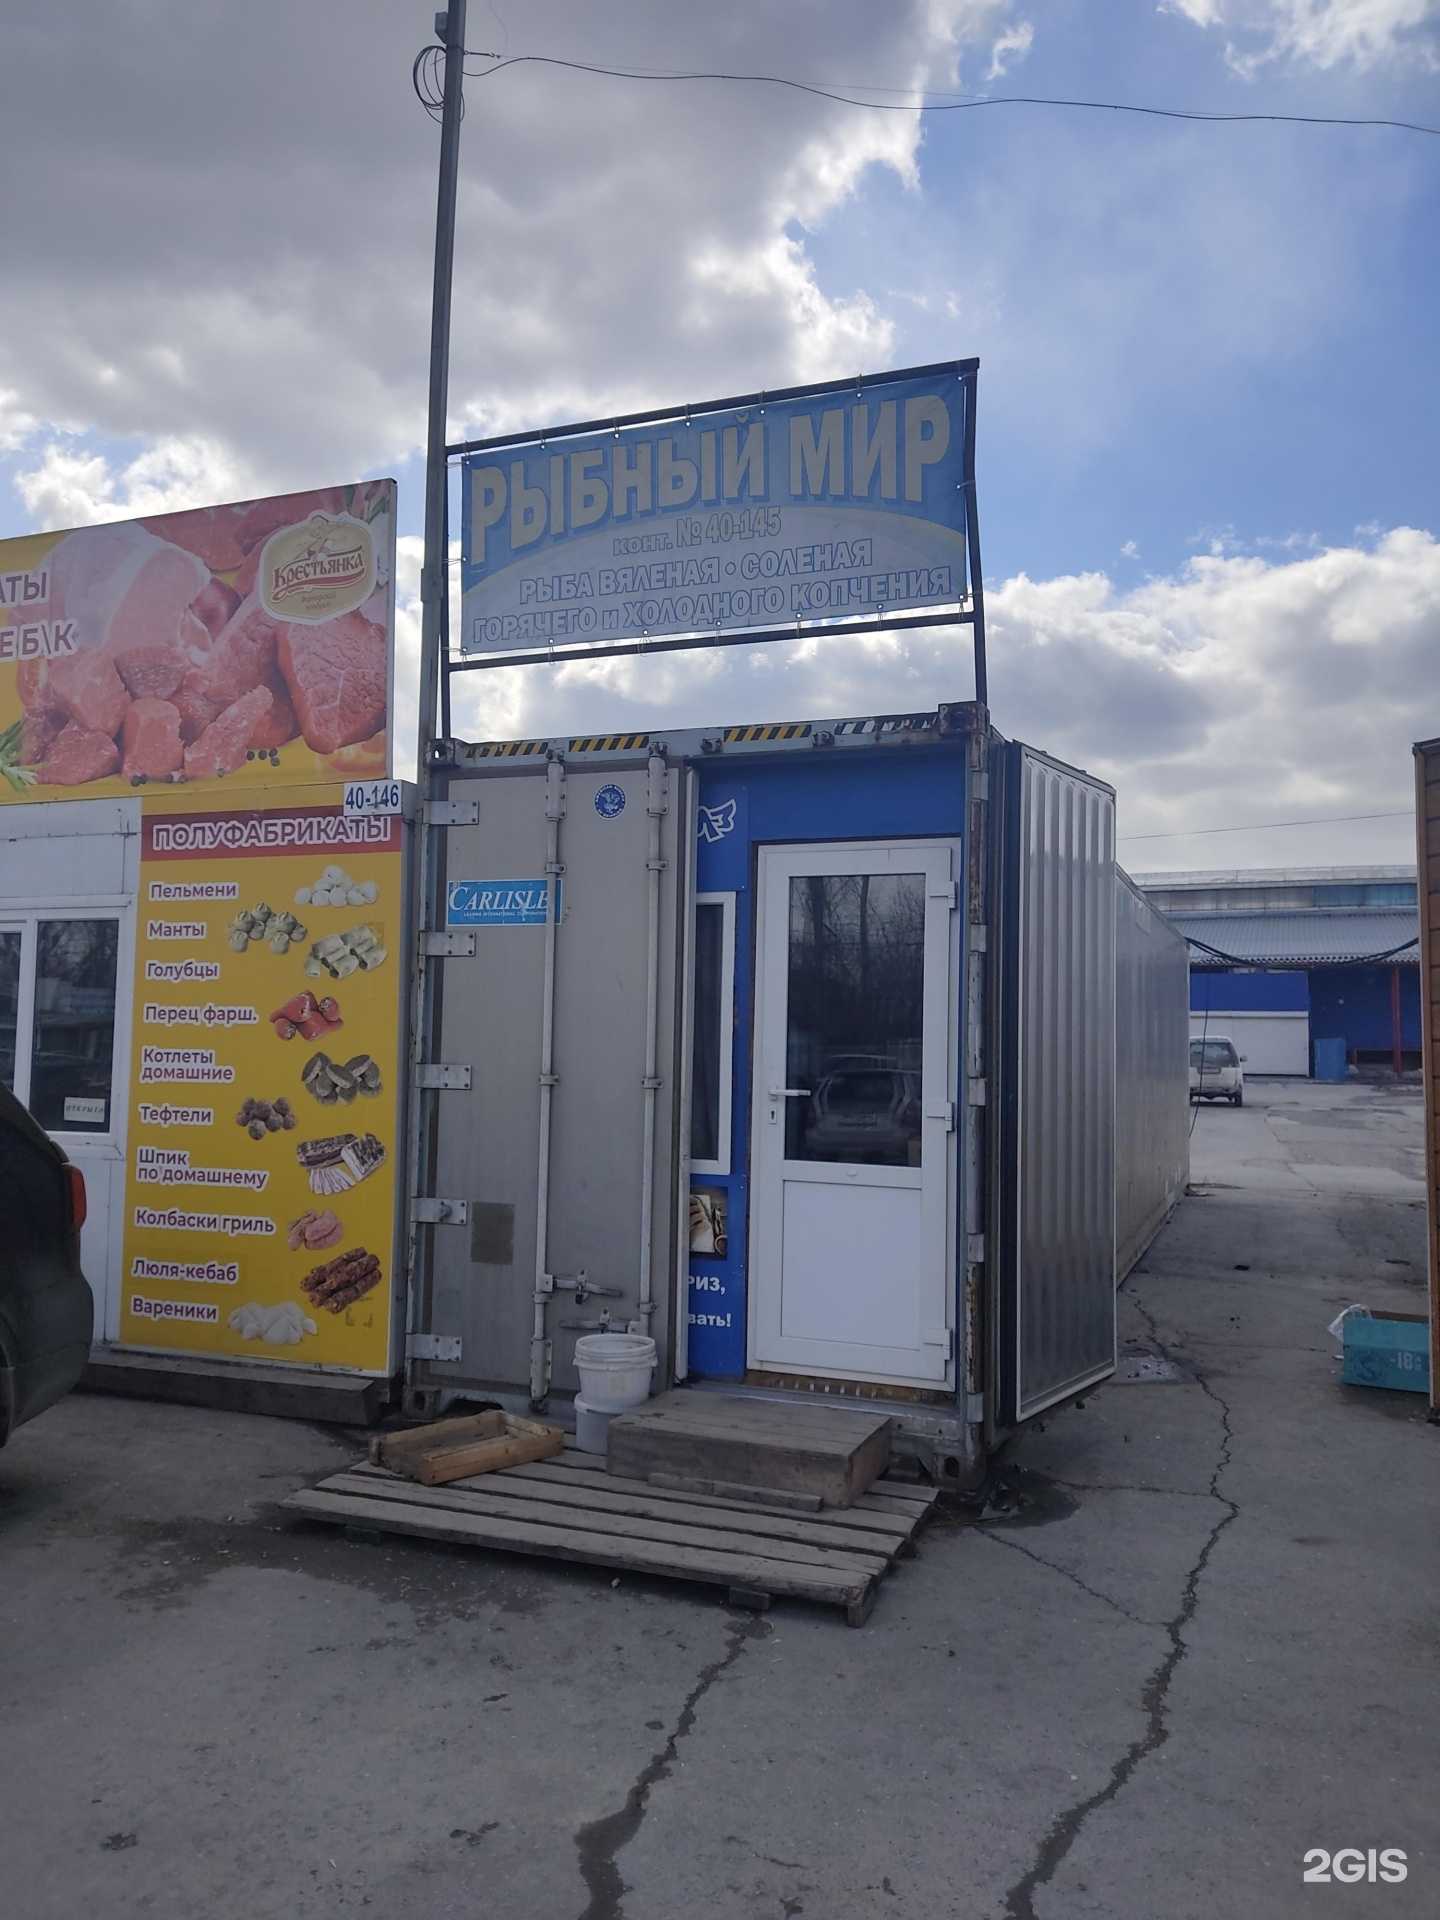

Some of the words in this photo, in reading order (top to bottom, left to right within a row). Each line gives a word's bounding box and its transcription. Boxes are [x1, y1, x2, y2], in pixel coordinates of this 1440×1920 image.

[470, 413, 765, 568] РЫБНЫЙ
[789, 394, 951, 504] МИР
[706, 505, 782, 544] 40-145
[520, 569, 593, 605] РЫБА
[599, 556, 720, 596] ВЯЛЕНАЯ
[741, 539, 873, 580] СОЛЕНАЯ
[473, 607, 598, 643] ГОРЯЧЕГО
[623, 587, 784, 627] ХОЛОДНОГО
[796, 566, 951, 611] КОПЧЕНИЯ
[345, 785, 399, 809] 40-146
[154, 818, 391, 849] ПОЛУФАБРИКАТЫ
[151, 883, 237, 898] Пельмени
[149, 923, 205, 937] Манты
[147, 963, 218, 980] Голубцы
[145, 1007, 199, 1024] Перец
[203, 1008, 258, 1024] фарш.
[143, 1049, 213, 1064] Котлеты
[142, 1067, 233, 1081] домашние
[140, 1106, 212, 1125] Тефтели
[139, 1150, 187, 1165] Шпик
[138, 1168, 158, 1181] по
[162, 1168, 267, 1188] домашнему
[136, 1210, 217, 1229] Колбаски
[222, 1219, 275, 1233] гриль
[133, 1260, 237, 1282] Люля-кебаб
[133, 1299, 217, 1321] Вареники
